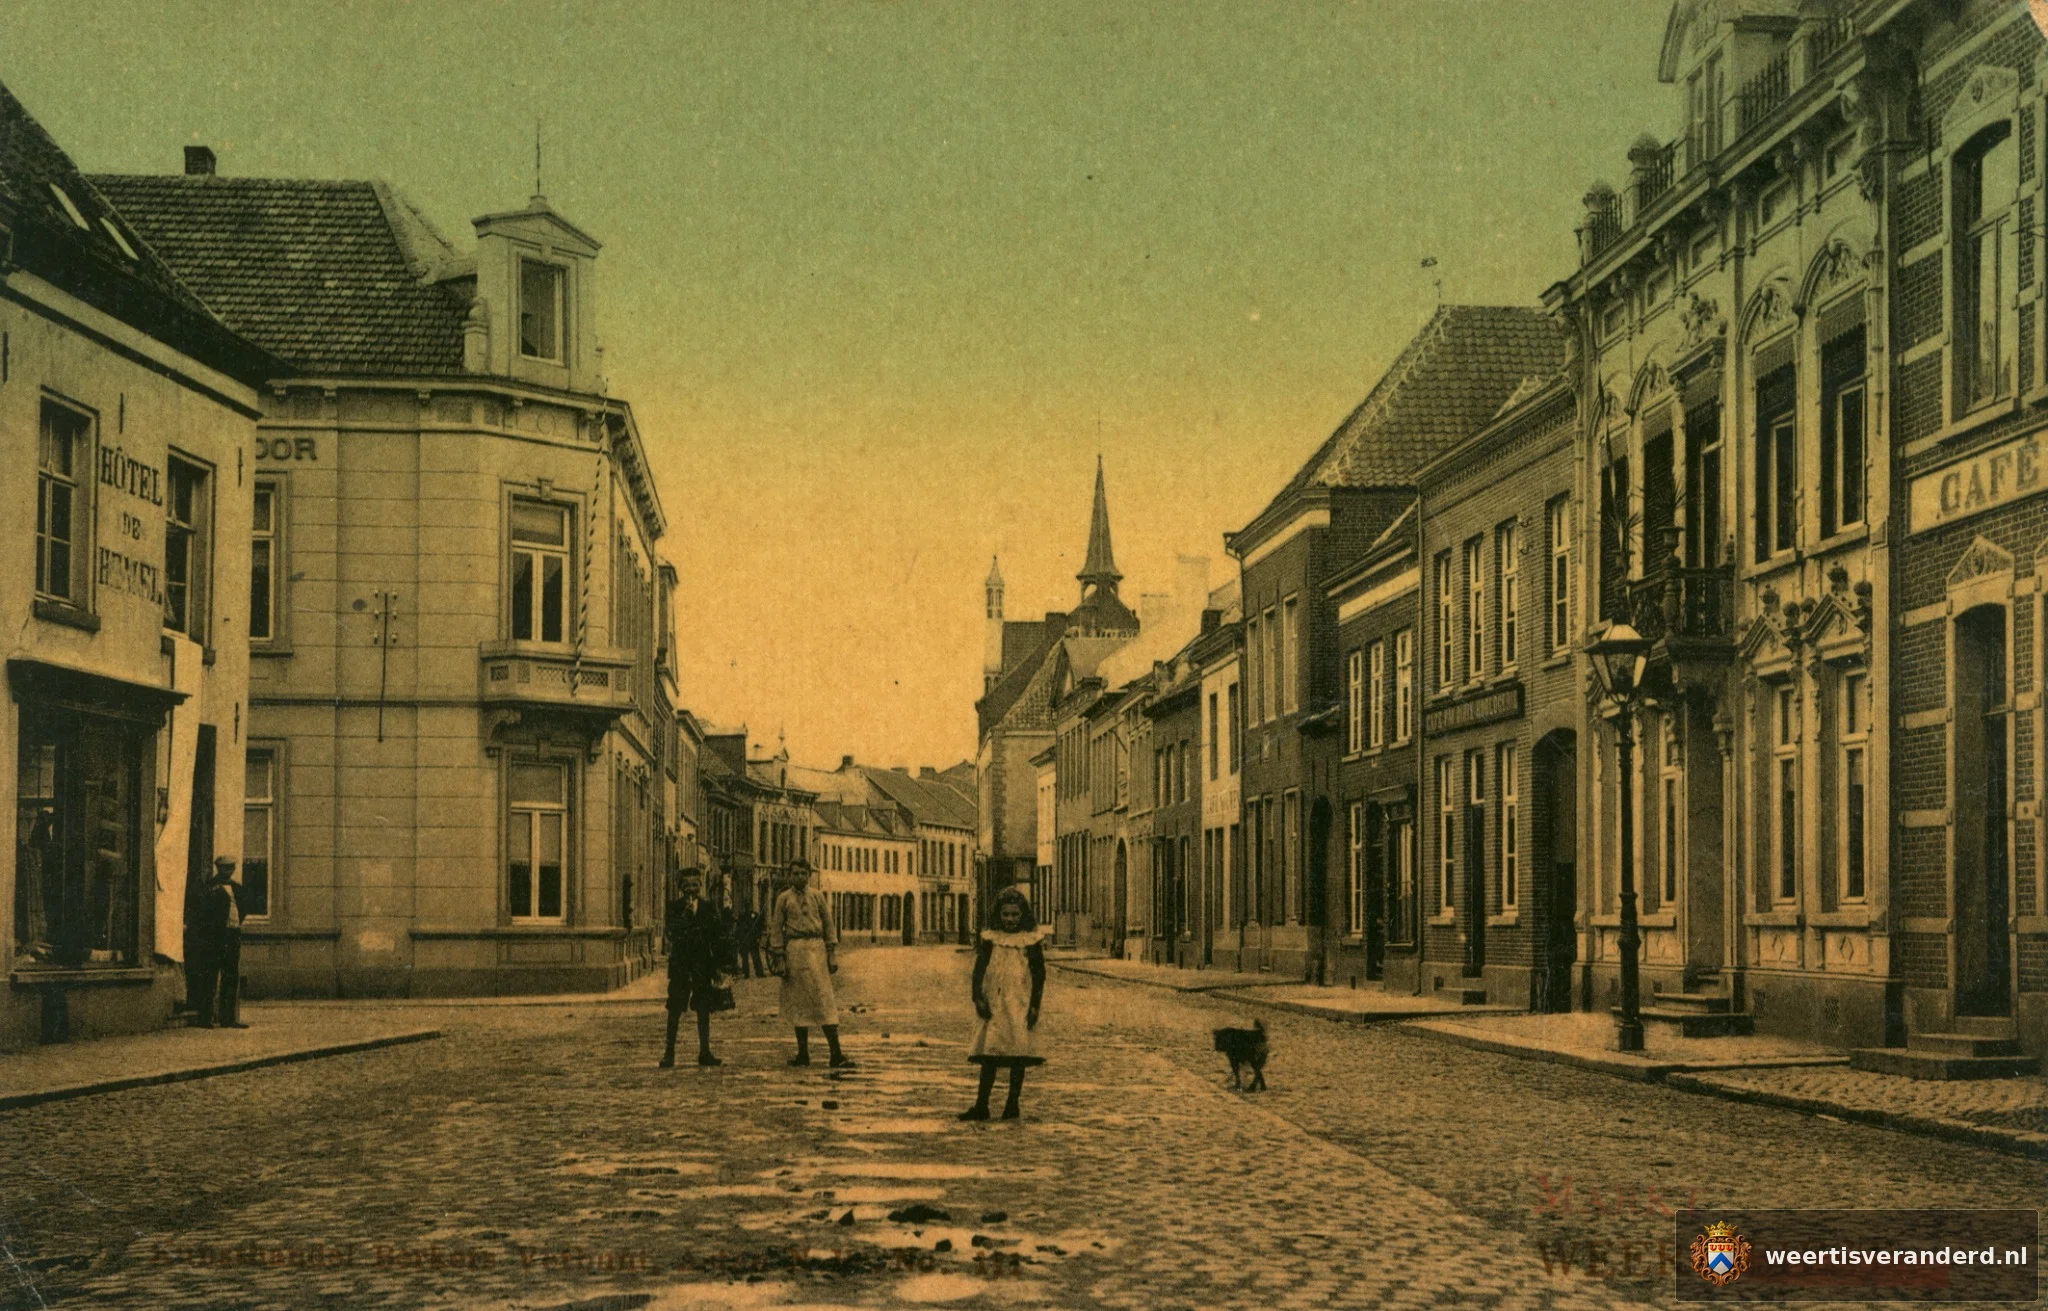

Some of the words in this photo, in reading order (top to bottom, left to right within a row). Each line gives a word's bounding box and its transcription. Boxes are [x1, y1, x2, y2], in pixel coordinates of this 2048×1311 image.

[101, 445, 163, 507] HÔTEL
[122, 512, 142, 541] DE
[98, 546, 163, 606] HEMEL
